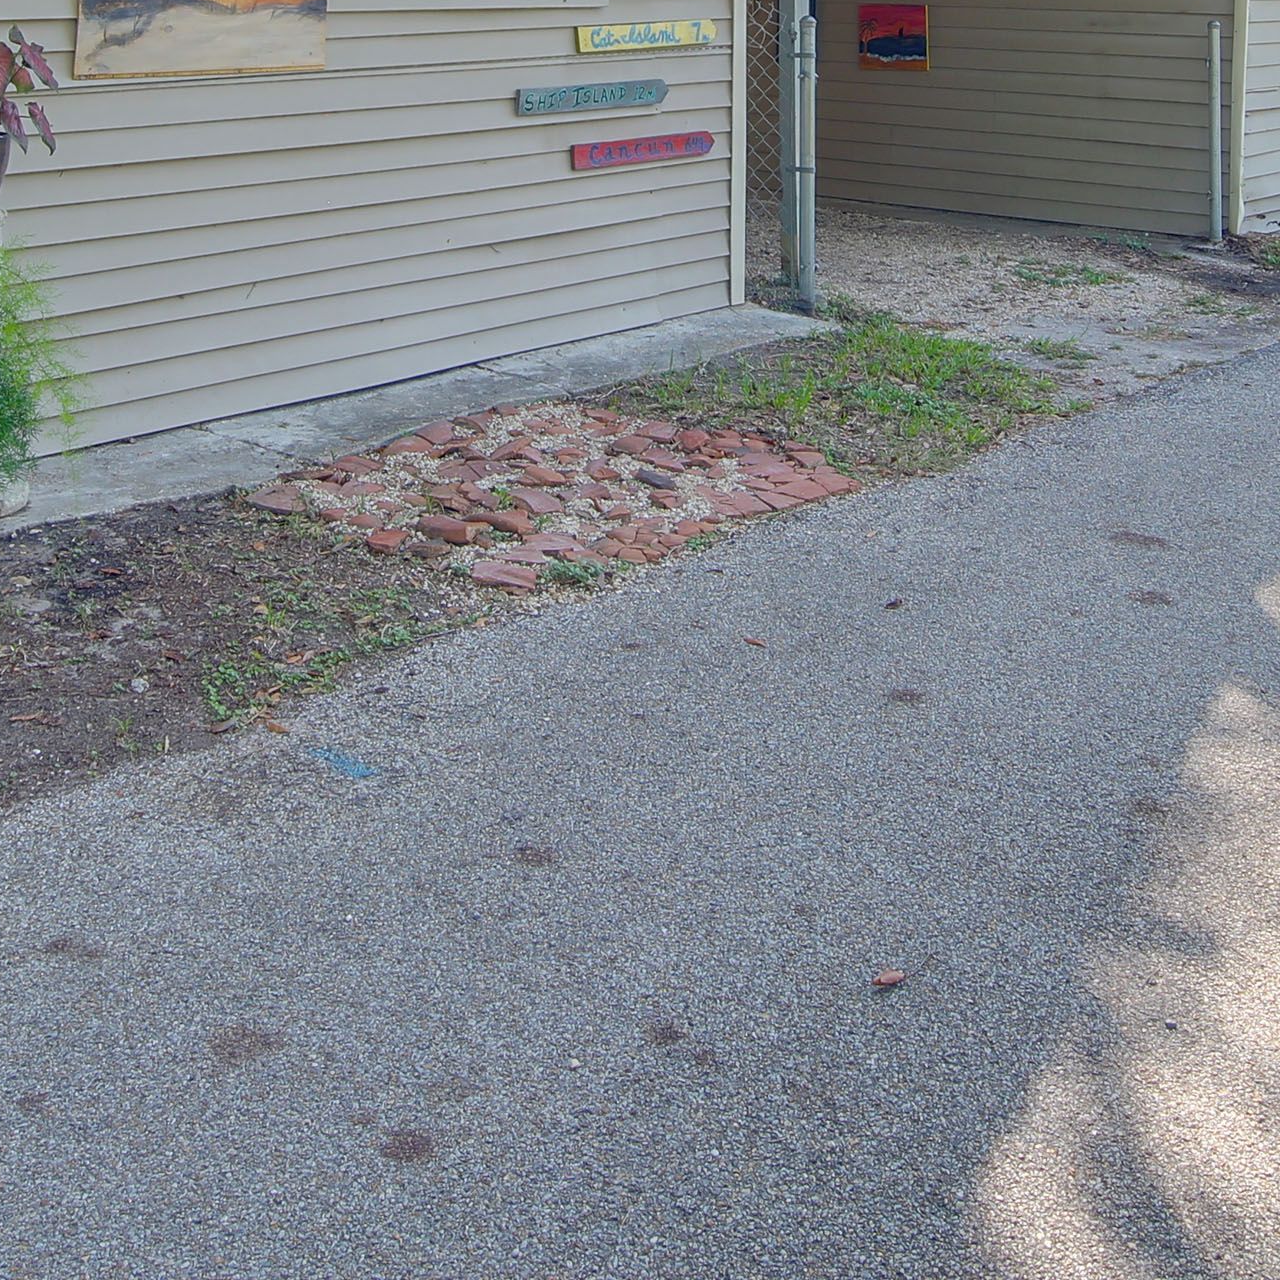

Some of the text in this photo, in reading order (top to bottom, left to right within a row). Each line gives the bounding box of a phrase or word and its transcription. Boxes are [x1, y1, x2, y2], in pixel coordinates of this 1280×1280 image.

[591, 27, 615, 50] Cat
[524, 88, 567, 113] SHIP
[571, 86, 627, 108] ISLAND
[589, 139, 676, 166] Cancun
